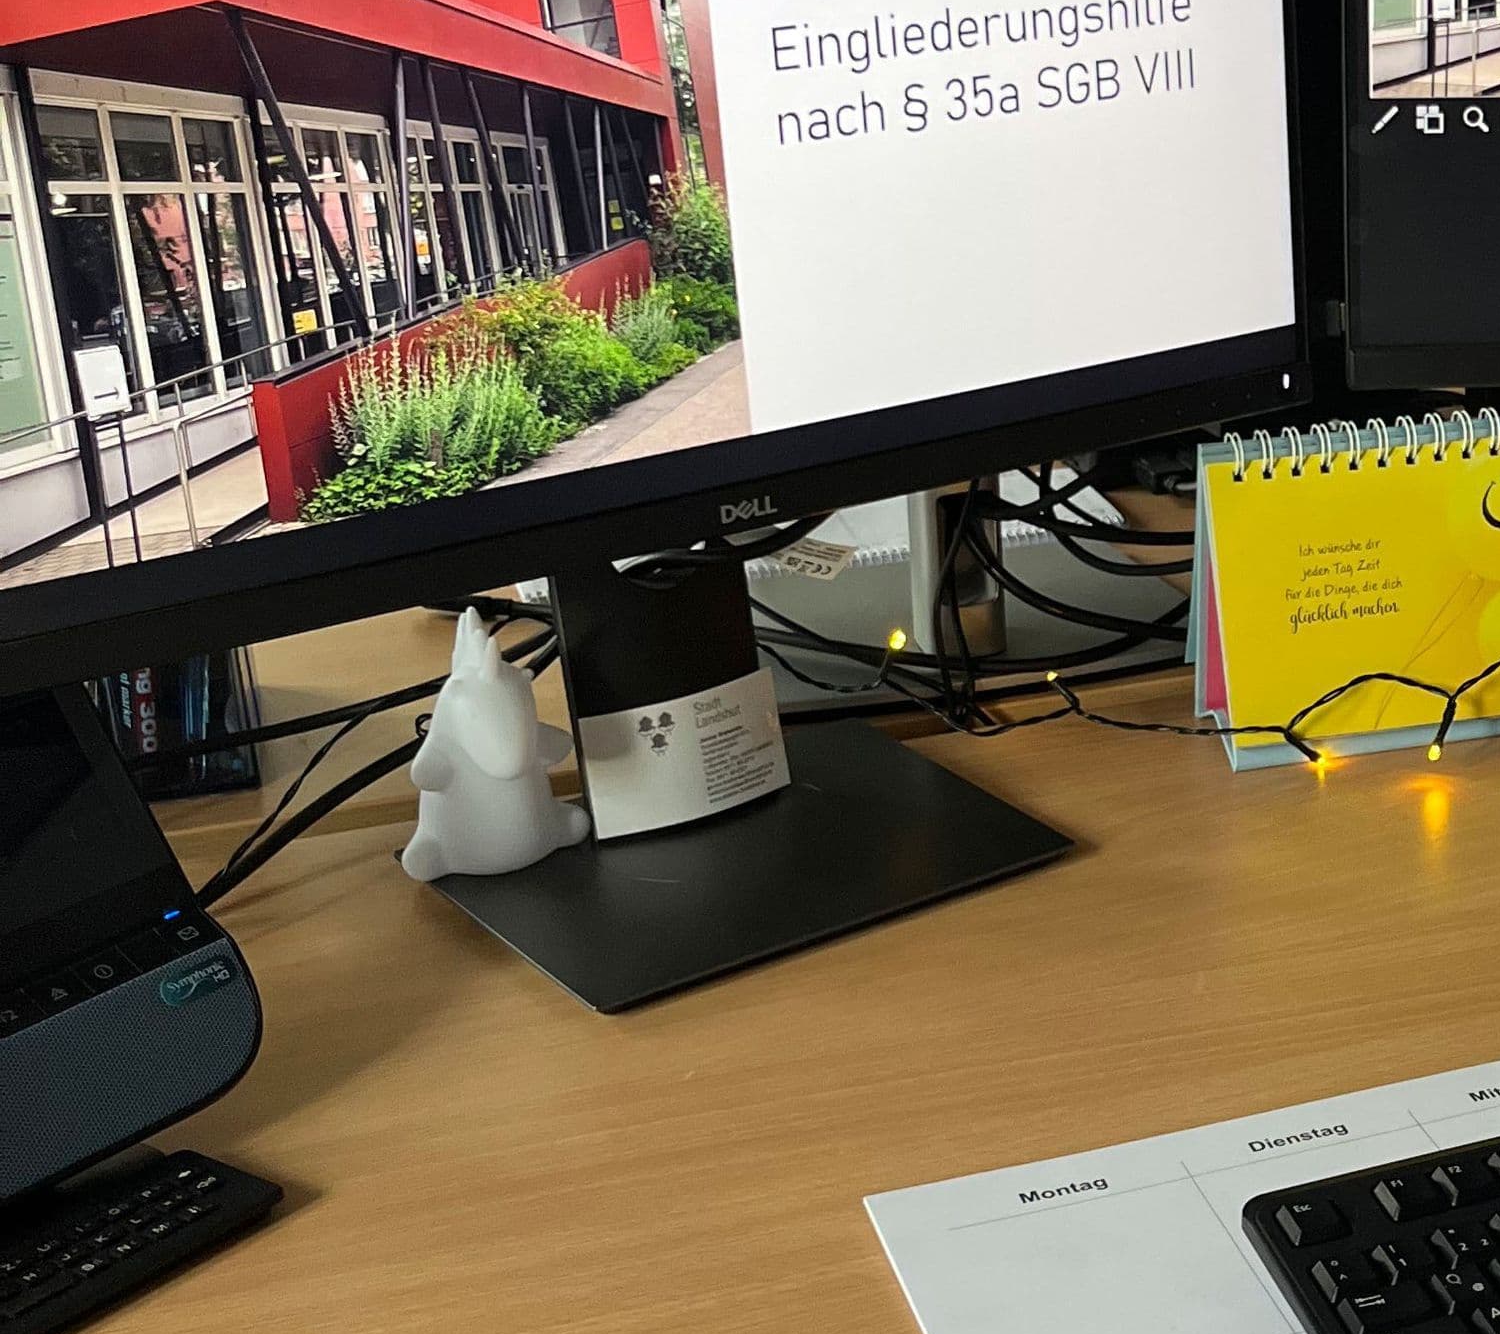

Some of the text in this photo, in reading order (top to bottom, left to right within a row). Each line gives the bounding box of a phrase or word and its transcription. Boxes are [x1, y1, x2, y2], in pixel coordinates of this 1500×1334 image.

[777, 48, 1196, 145] nach § 35a SGB VIII
[720, 495, 778, 525] DELL
[1299, 538, 1381, 557] Ich wünsche dir
[1301, 559, 1381, 581] jeden Tag Zeit
[1305, 586, 1320, 598] die
[1362, 581, 1378, 592] die
[1381, 577, 1403, 590] dich
[1290, 601, 1348, 634] glücklich
[1248, 1124, 1349, 1154] Dienstag
[1018, 1173, 1109, 1205] Montag
[1292, 1202, 1312, 1214] Esc
[1446, 1274, 1462, 1285] Q
